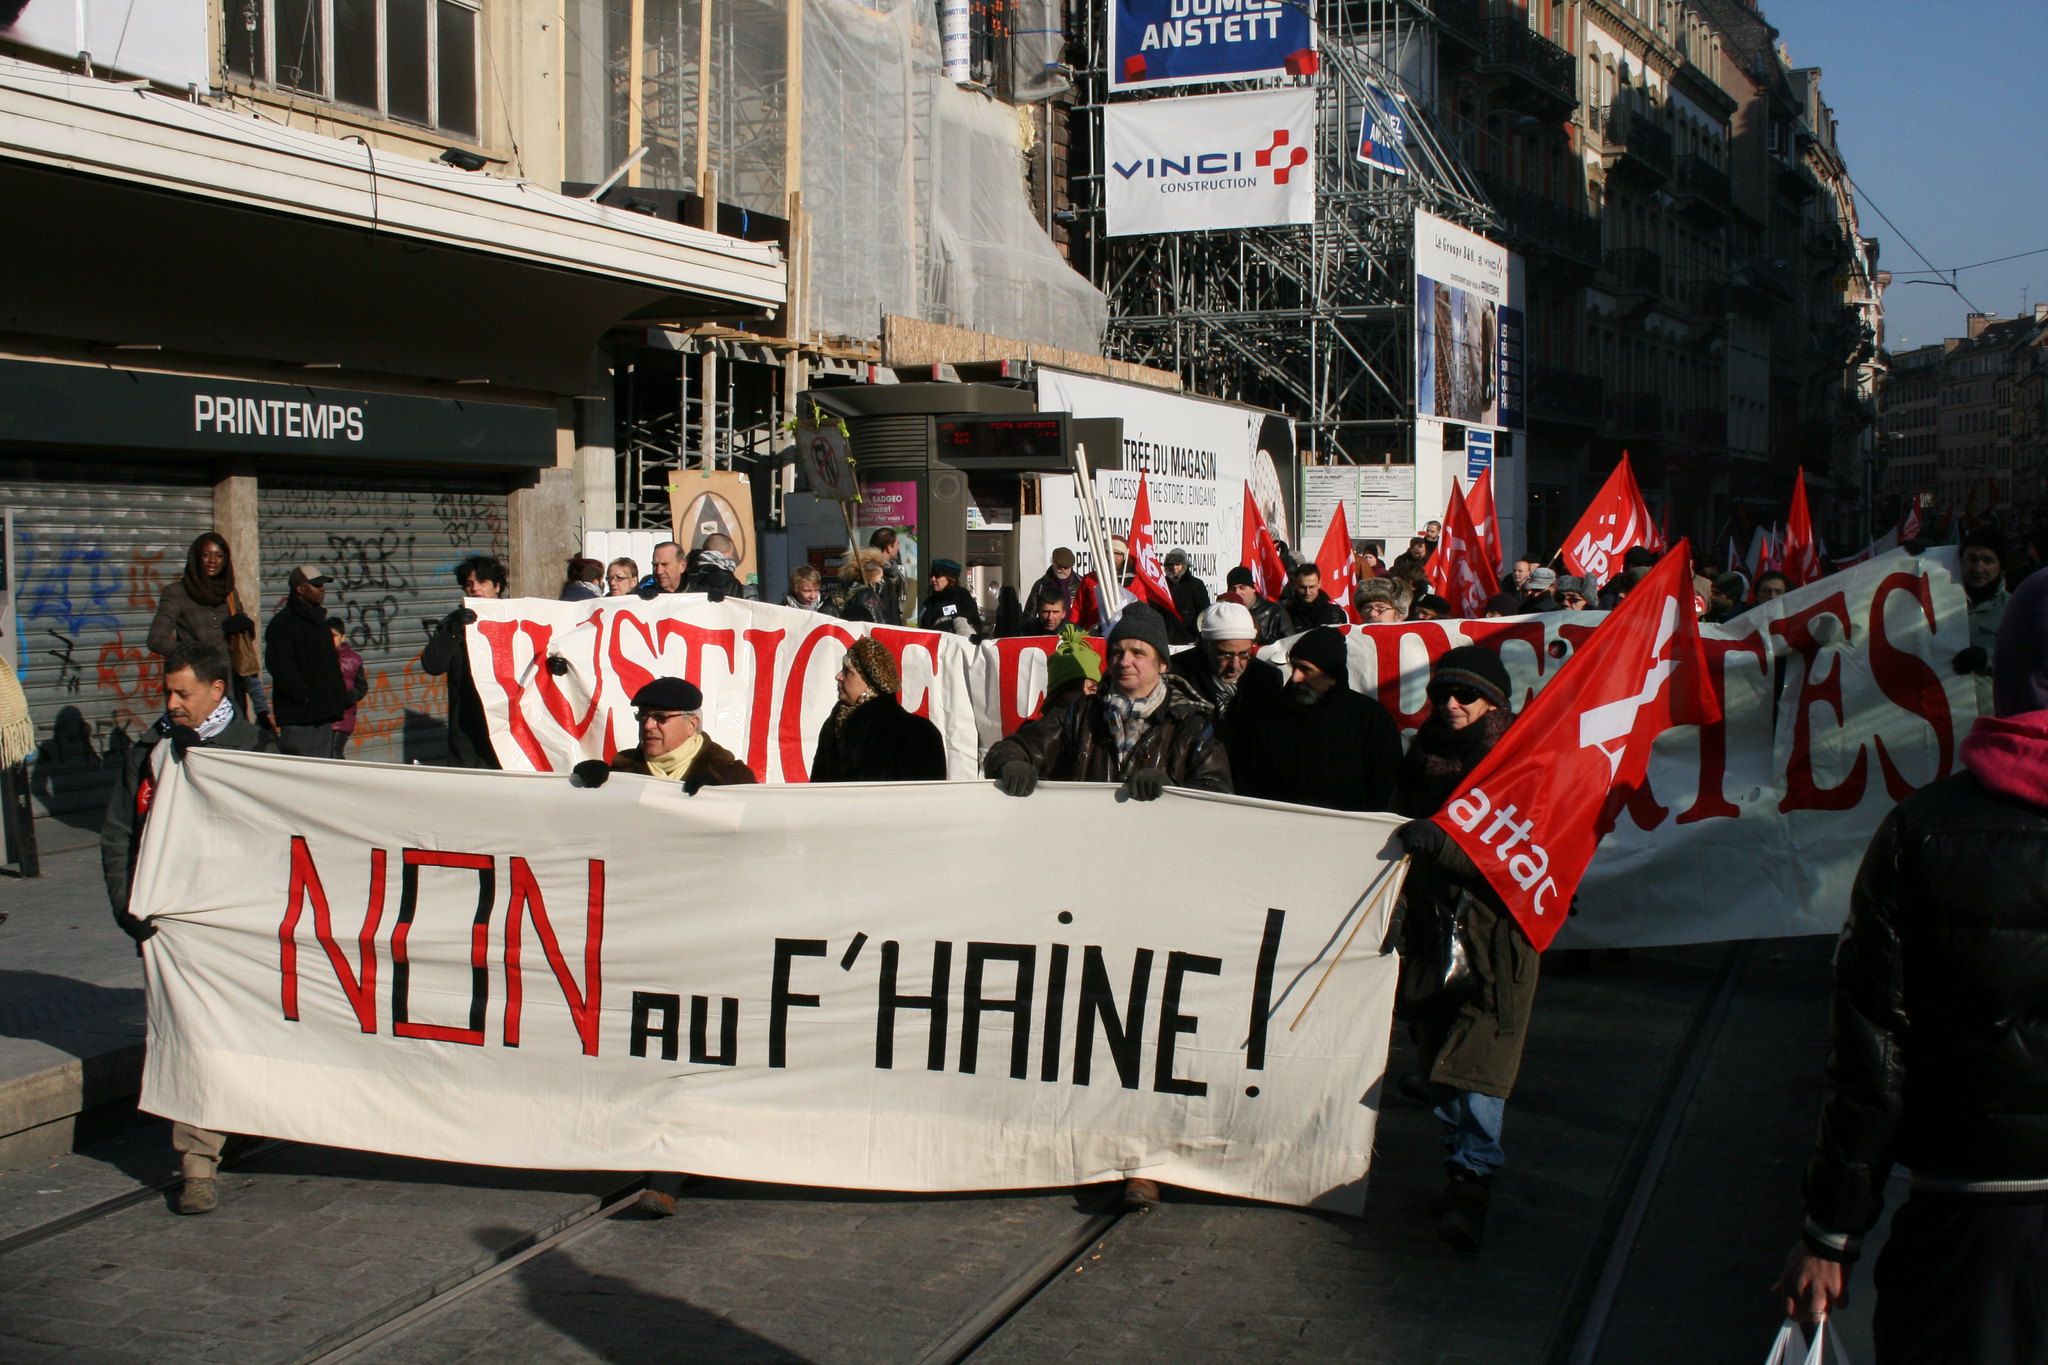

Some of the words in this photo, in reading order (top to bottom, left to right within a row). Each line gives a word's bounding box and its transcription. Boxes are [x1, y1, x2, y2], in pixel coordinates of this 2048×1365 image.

[1140, 11, 1283, 51] ANSTETT
[1111, 152, 1242, 180] VINCI
[1160, 177, 1257, 194] CONSTRUCTION
[194, 394, 364, 442] PRINTEMPS
[1123, 432, 1151, 474] TRÉE
[1153, 443, 1169, 476] DU
[1170, 446, 1217, 482] MAGASIN
[1108, 477, 1137, 501] ACCESS
[1149, 481, 1163, 503] THE
[1163, 483, 1184, 505] STORE
[1153, 519, 1179, 546] RESTE
[1179, 521, 1210, 546] OUVERT
[1185, 553, 1218, 577] RAVAUX
[1447, 787, 1558, 916] attac
[278, 834, 605, 1057] NON
[629, 990, 739, 1067] AU
